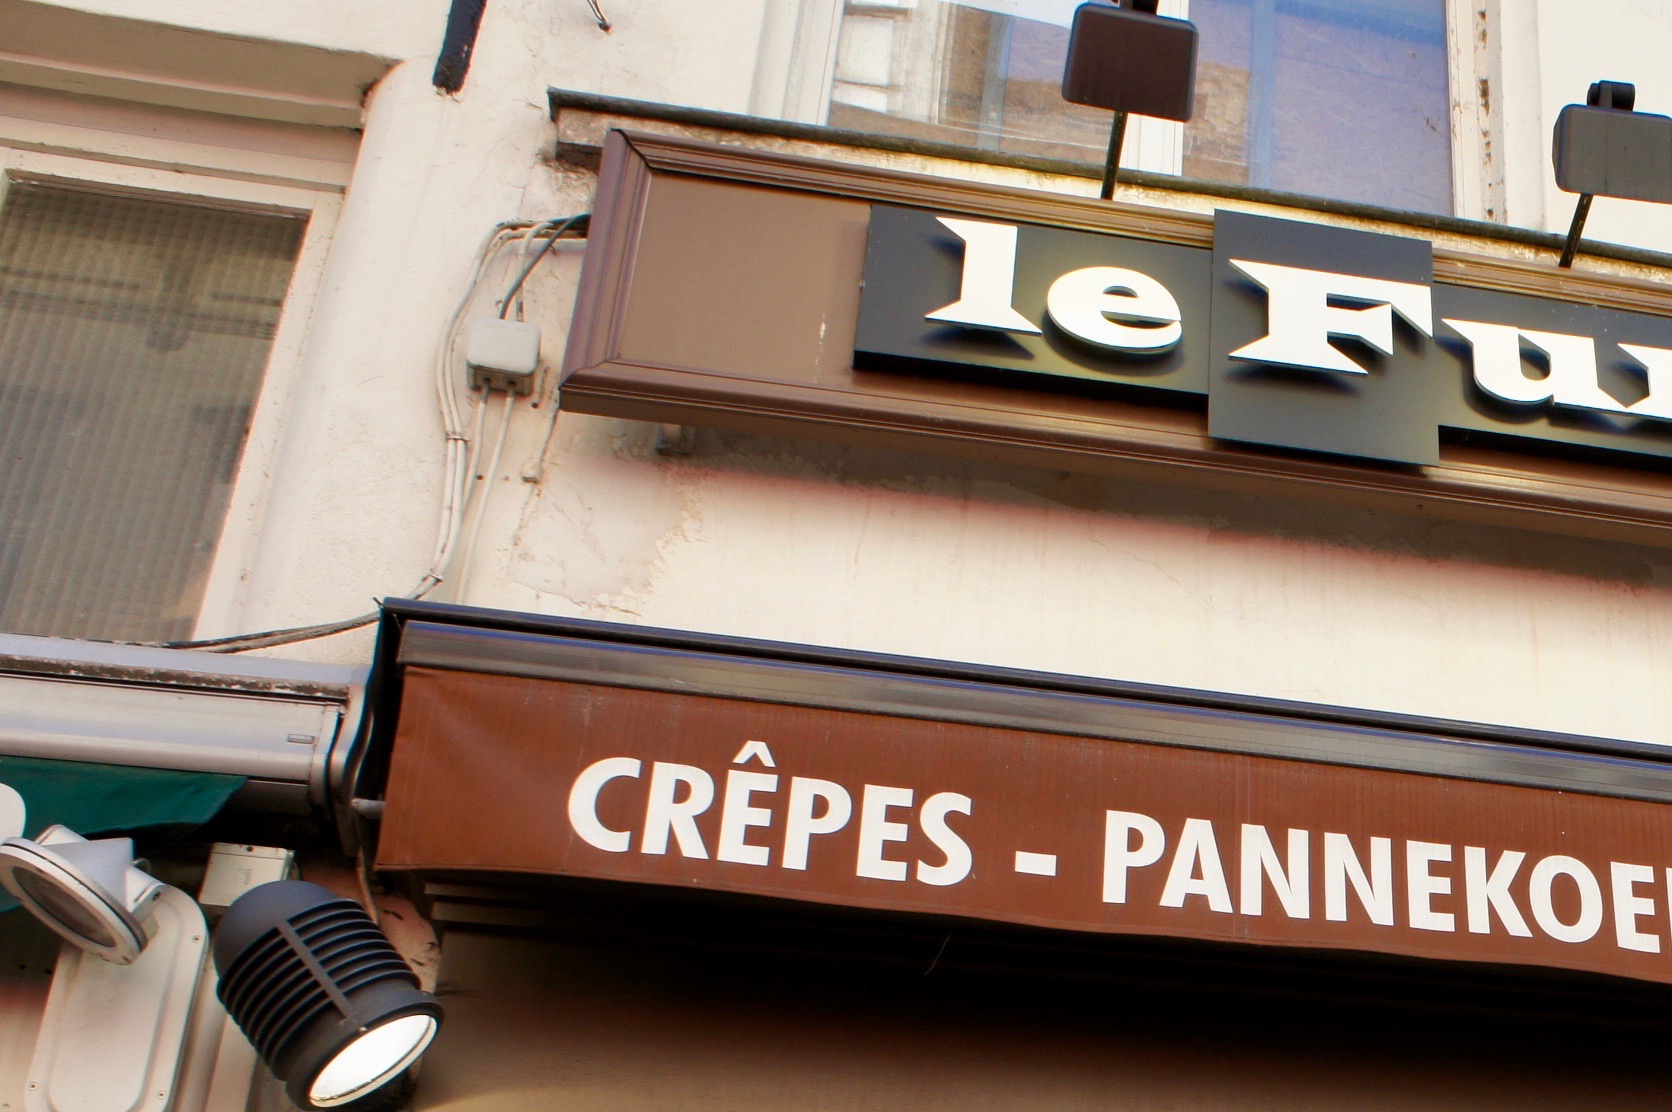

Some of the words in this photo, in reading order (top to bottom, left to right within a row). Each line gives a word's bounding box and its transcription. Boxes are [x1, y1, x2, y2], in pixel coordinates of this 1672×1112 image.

[925, 216, 1183, 354] le
[567, 740, 974, 887] CRÊPES
[1014, 850, 1057, 877] -
